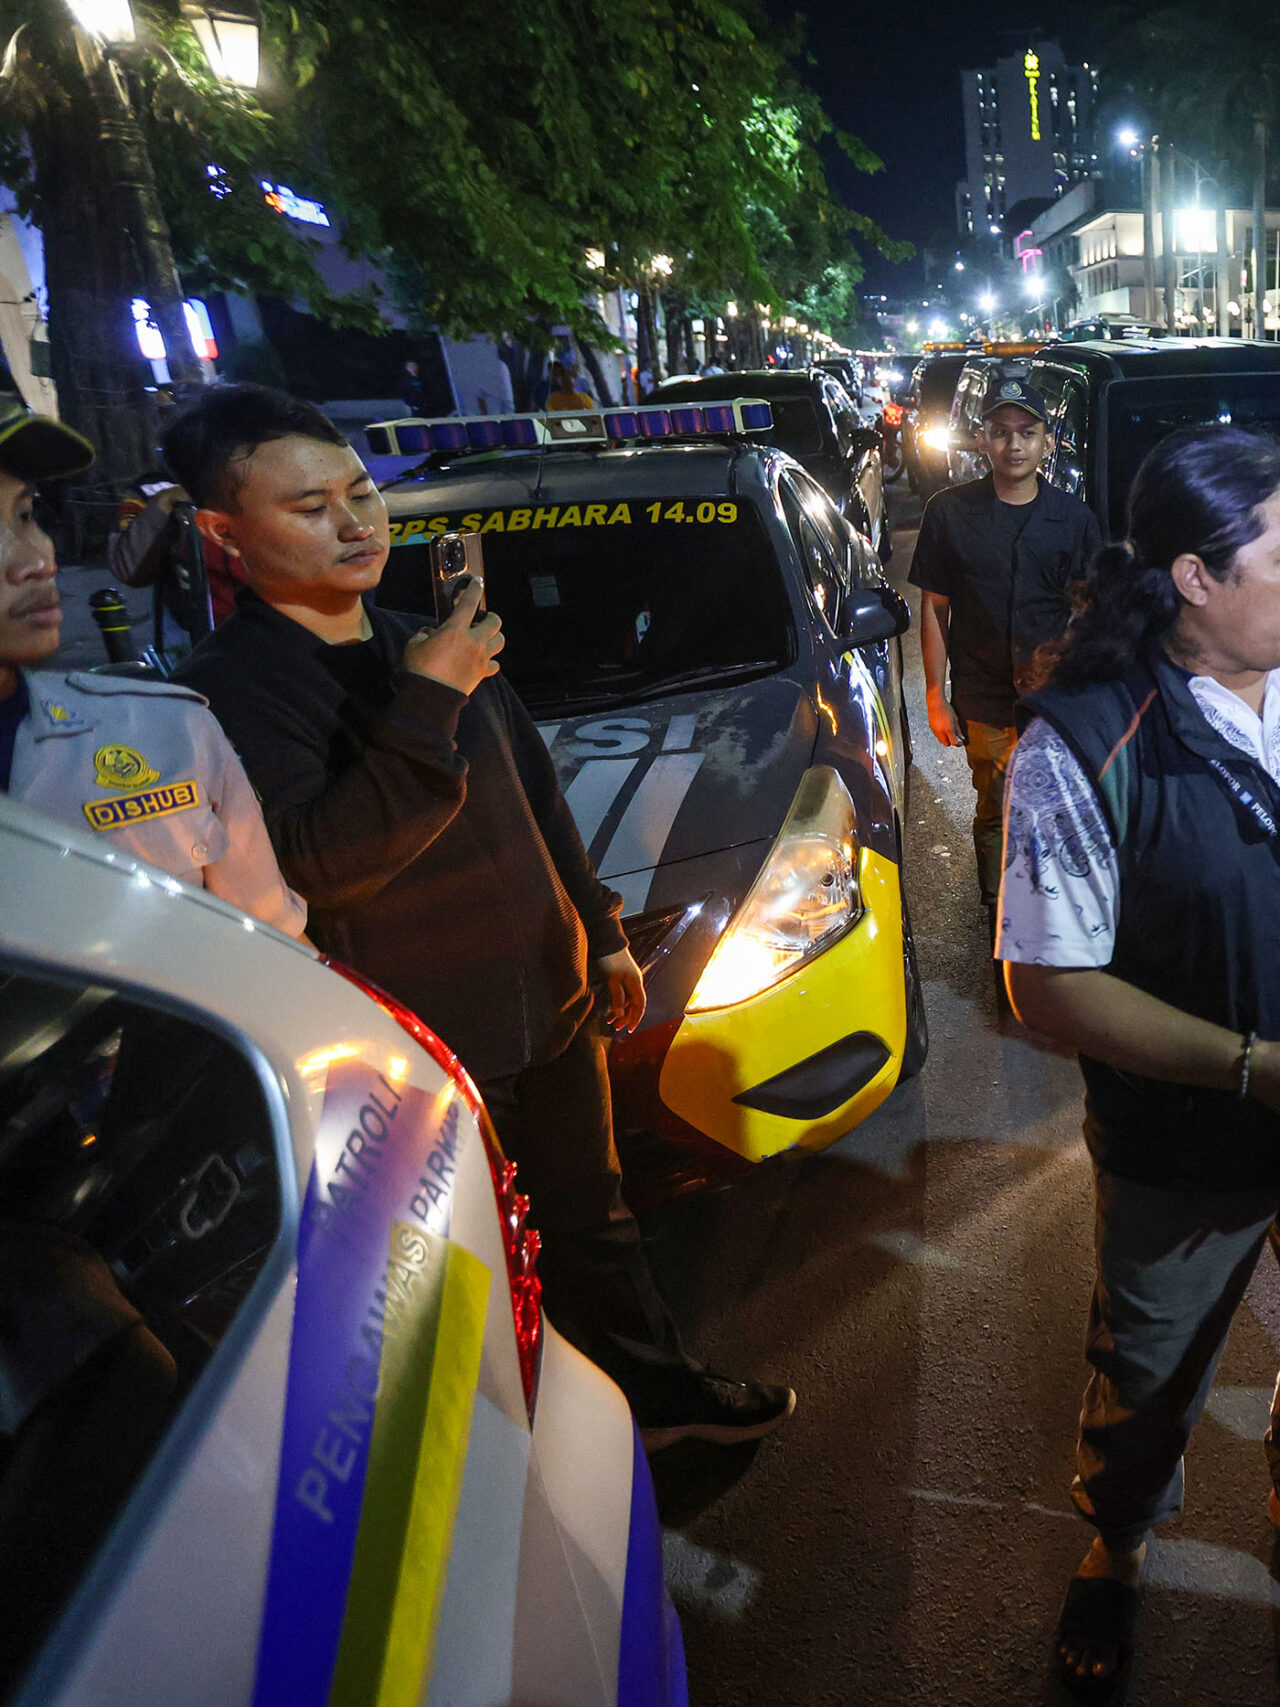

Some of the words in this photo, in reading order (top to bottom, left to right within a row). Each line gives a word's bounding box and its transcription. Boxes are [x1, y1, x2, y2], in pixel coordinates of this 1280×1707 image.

[461, 503, 633, 535] SABHARA
[646, 501, 738, 524] 14.09
[94, 787, 191, 822] DISHUB
[312, 1074, 402, 1231] PATROLI
